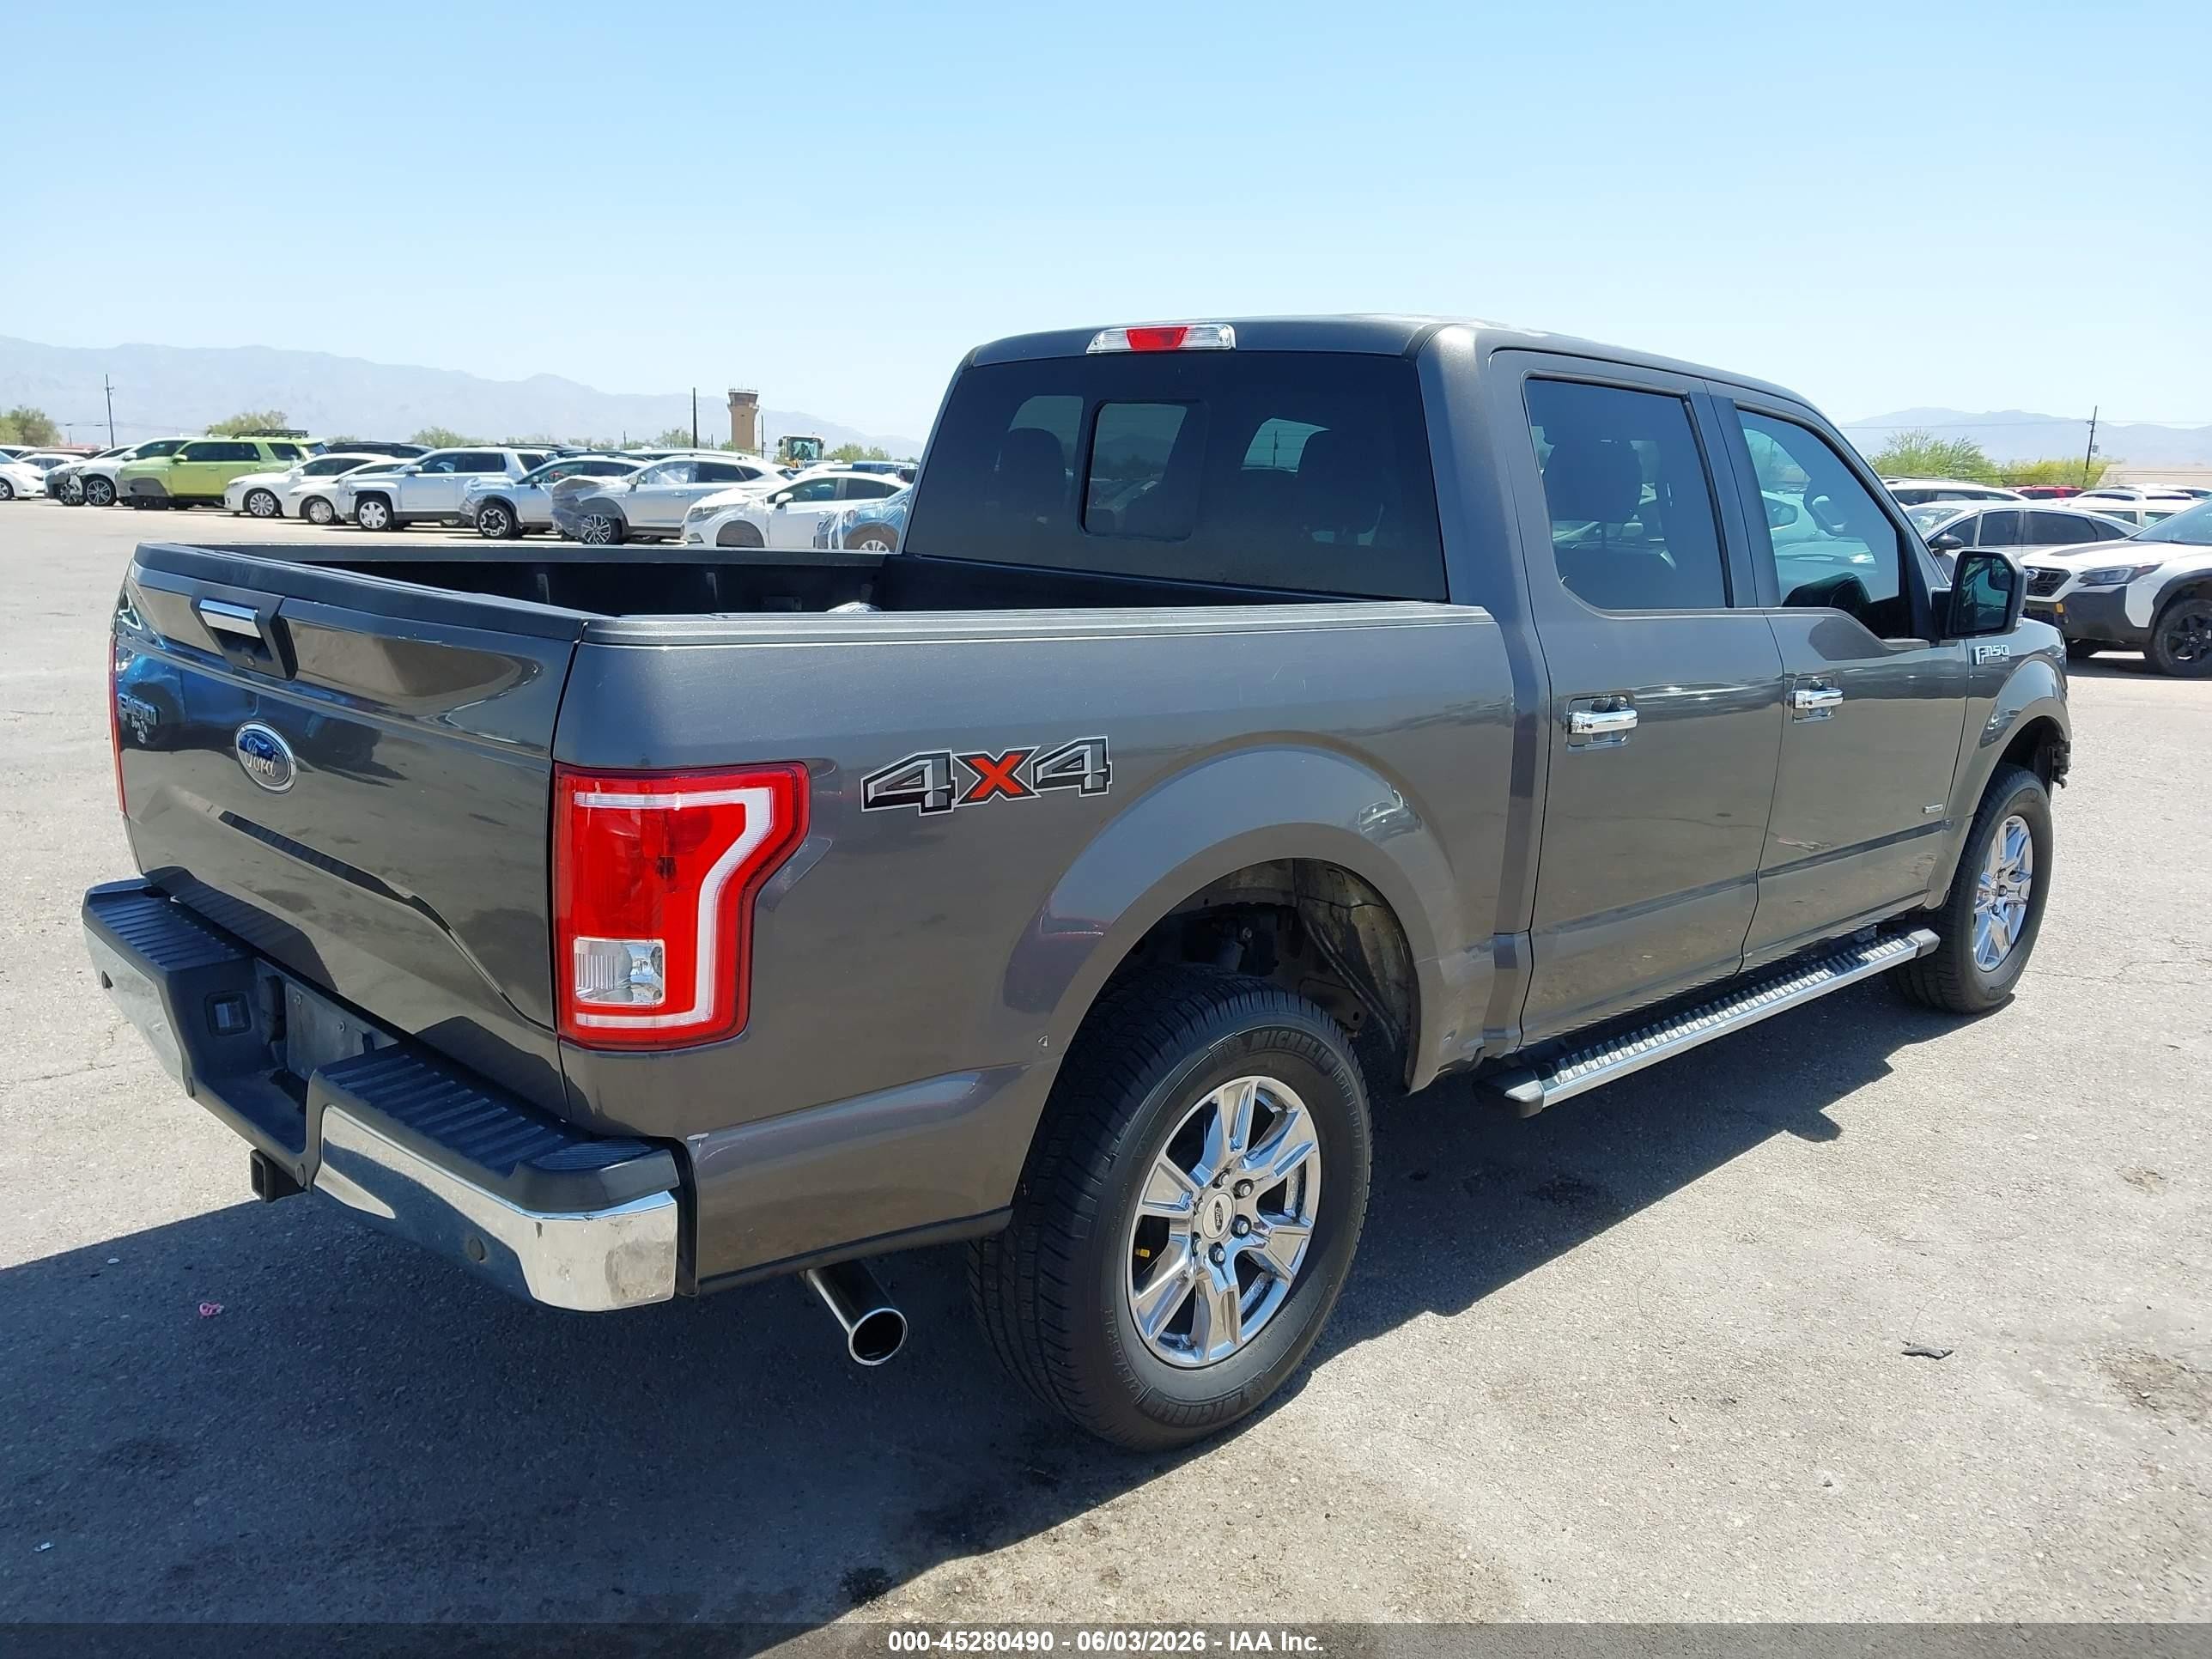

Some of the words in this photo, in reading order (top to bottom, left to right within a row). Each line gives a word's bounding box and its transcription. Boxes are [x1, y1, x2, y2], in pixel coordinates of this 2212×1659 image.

[244, 737, 276, 777] Ford
[1249, 1030, 1336, 1071] MICHELIN
[1215, 1207, 1224, 1226] Ford
